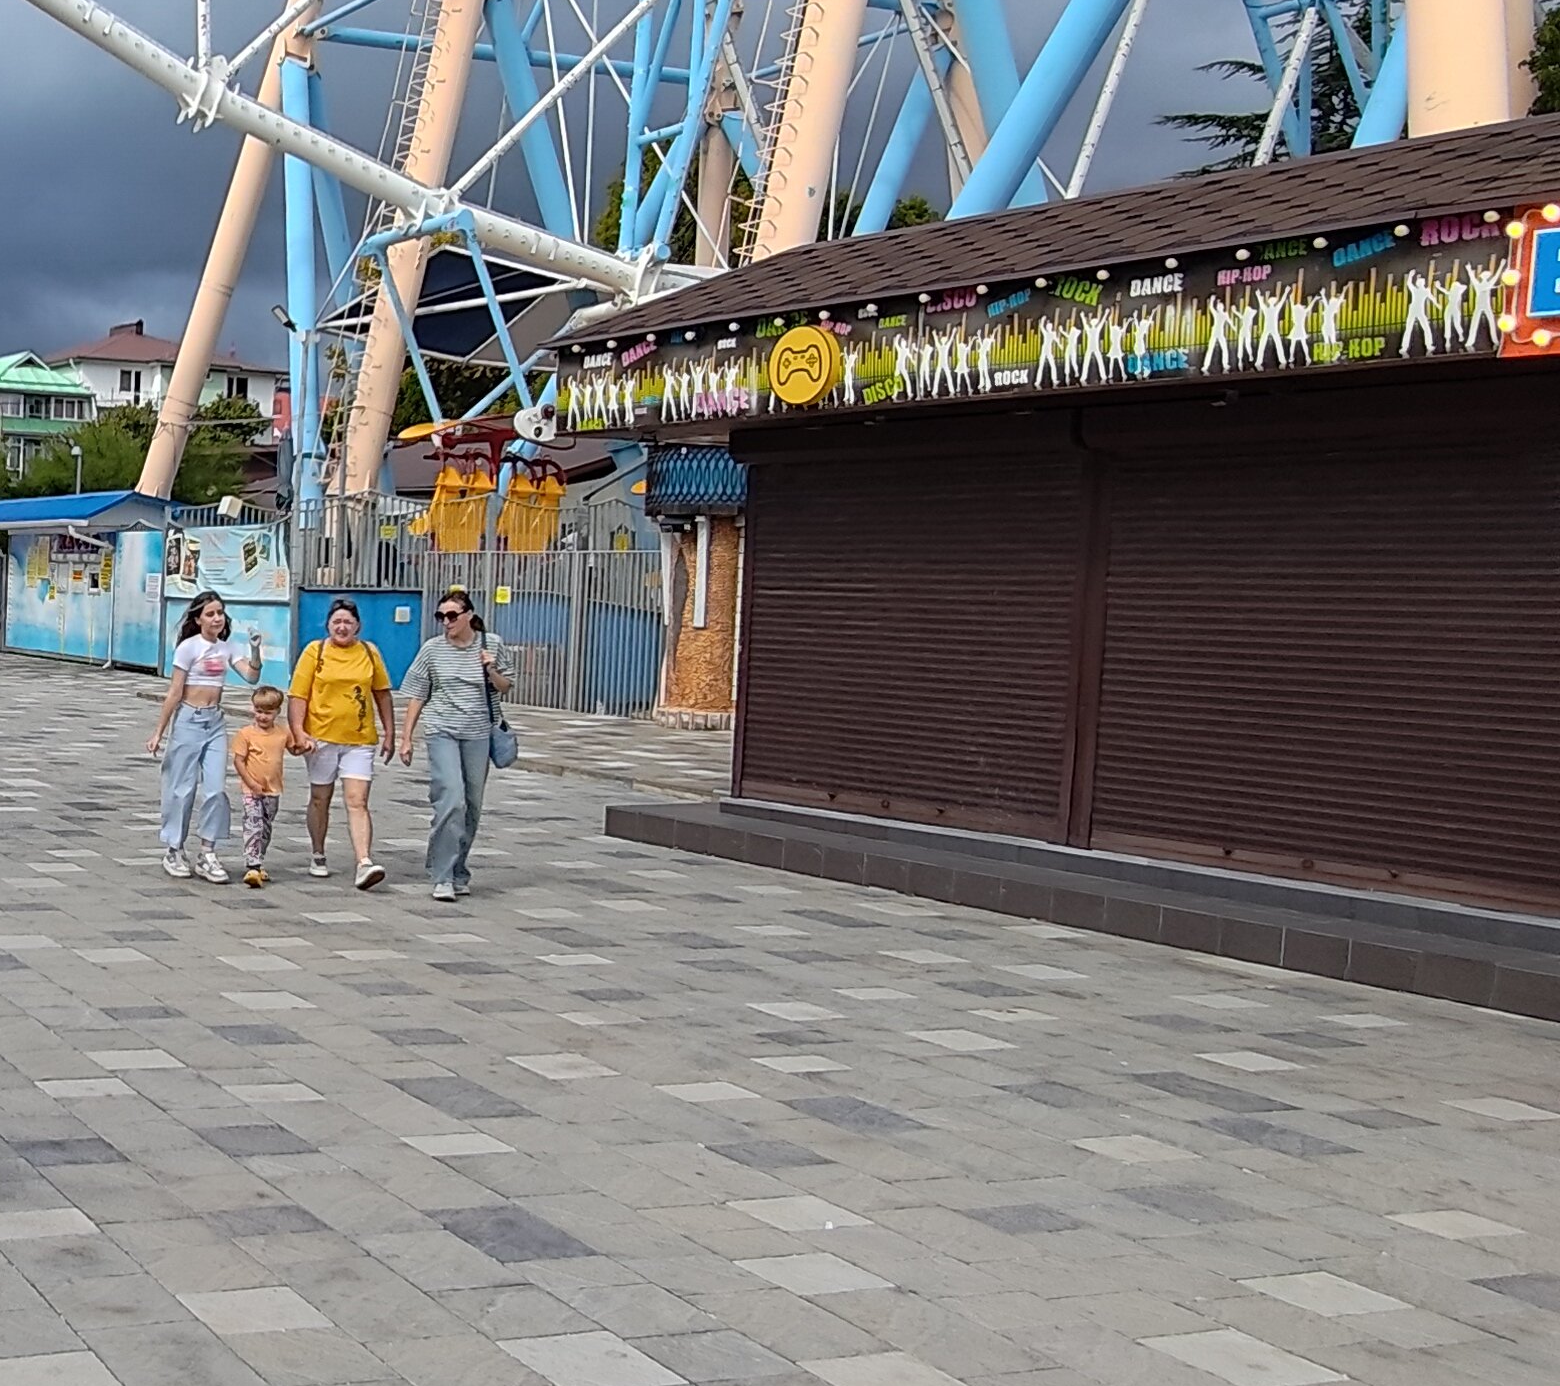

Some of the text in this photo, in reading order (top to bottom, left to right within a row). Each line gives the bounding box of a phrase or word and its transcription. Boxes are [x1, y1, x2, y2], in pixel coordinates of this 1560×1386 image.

[1333, 230, 1396, 268] DANCE
[1129, 273, 1184, 298] DANCE
[1217, 265, 1272, 286] HIP-HOP
[987, 288, 1032, 318] HIP-HOP
[583, 352, 613, 370] DANCE
[1313, 337, 1385, 362] HIP-HOP
[862, 375, 903, 405] DISCO
[994, 369, 1028, 386] ROCK
